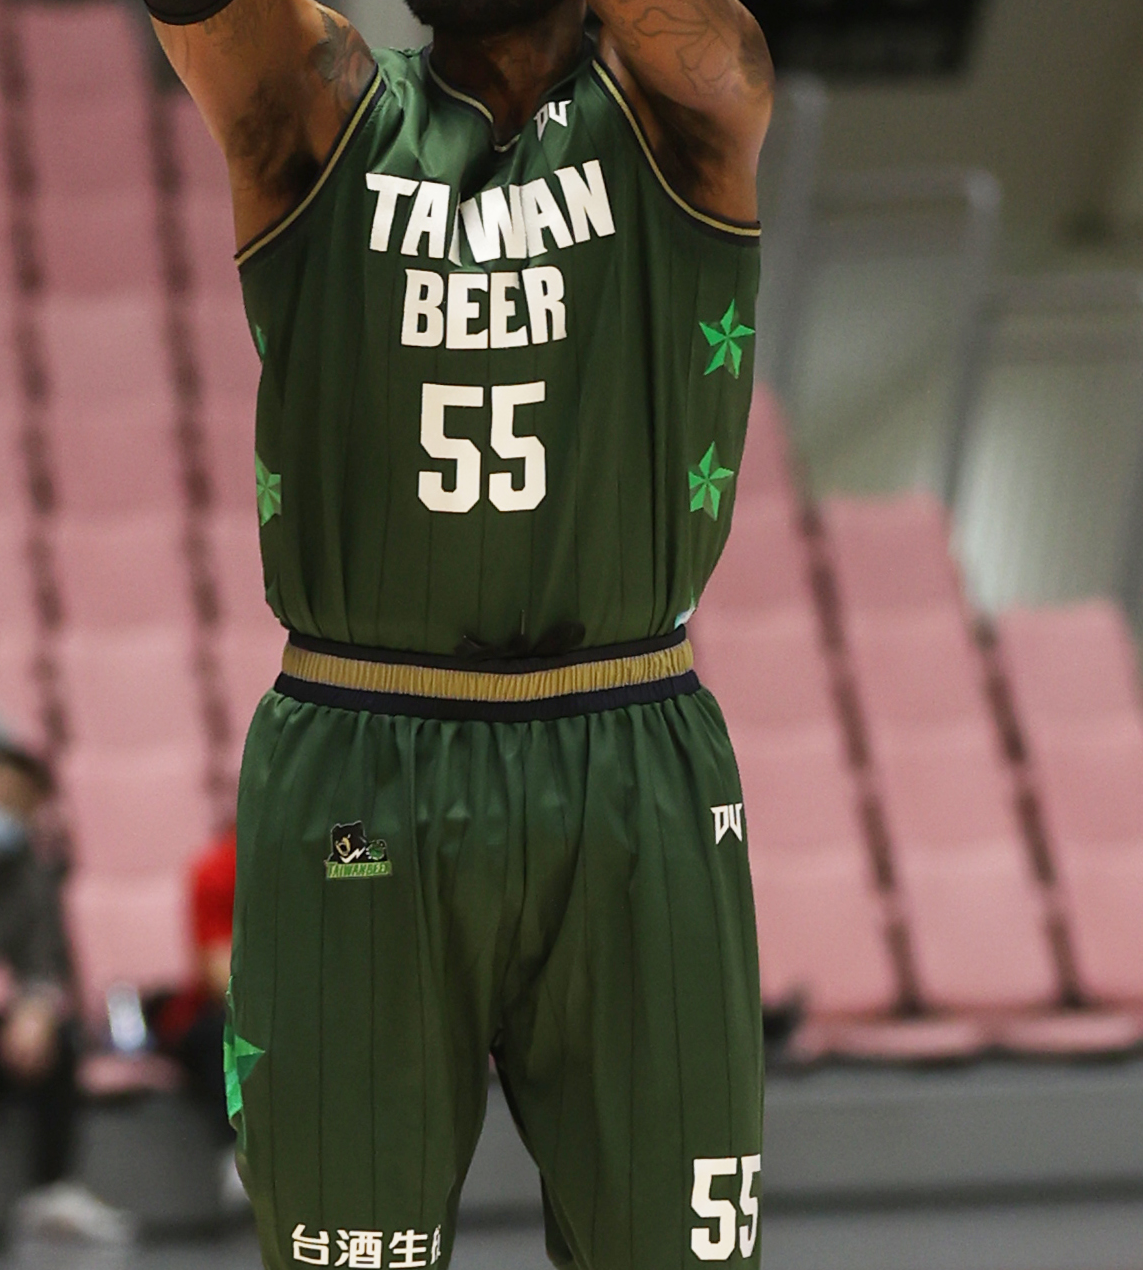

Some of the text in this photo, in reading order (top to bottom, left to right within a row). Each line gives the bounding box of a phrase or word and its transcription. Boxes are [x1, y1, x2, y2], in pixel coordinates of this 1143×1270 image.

[400, 265, 568, 350] BEER
[418, 381, 546, 514] 55
[690, 1152, 762, 1261] 55
